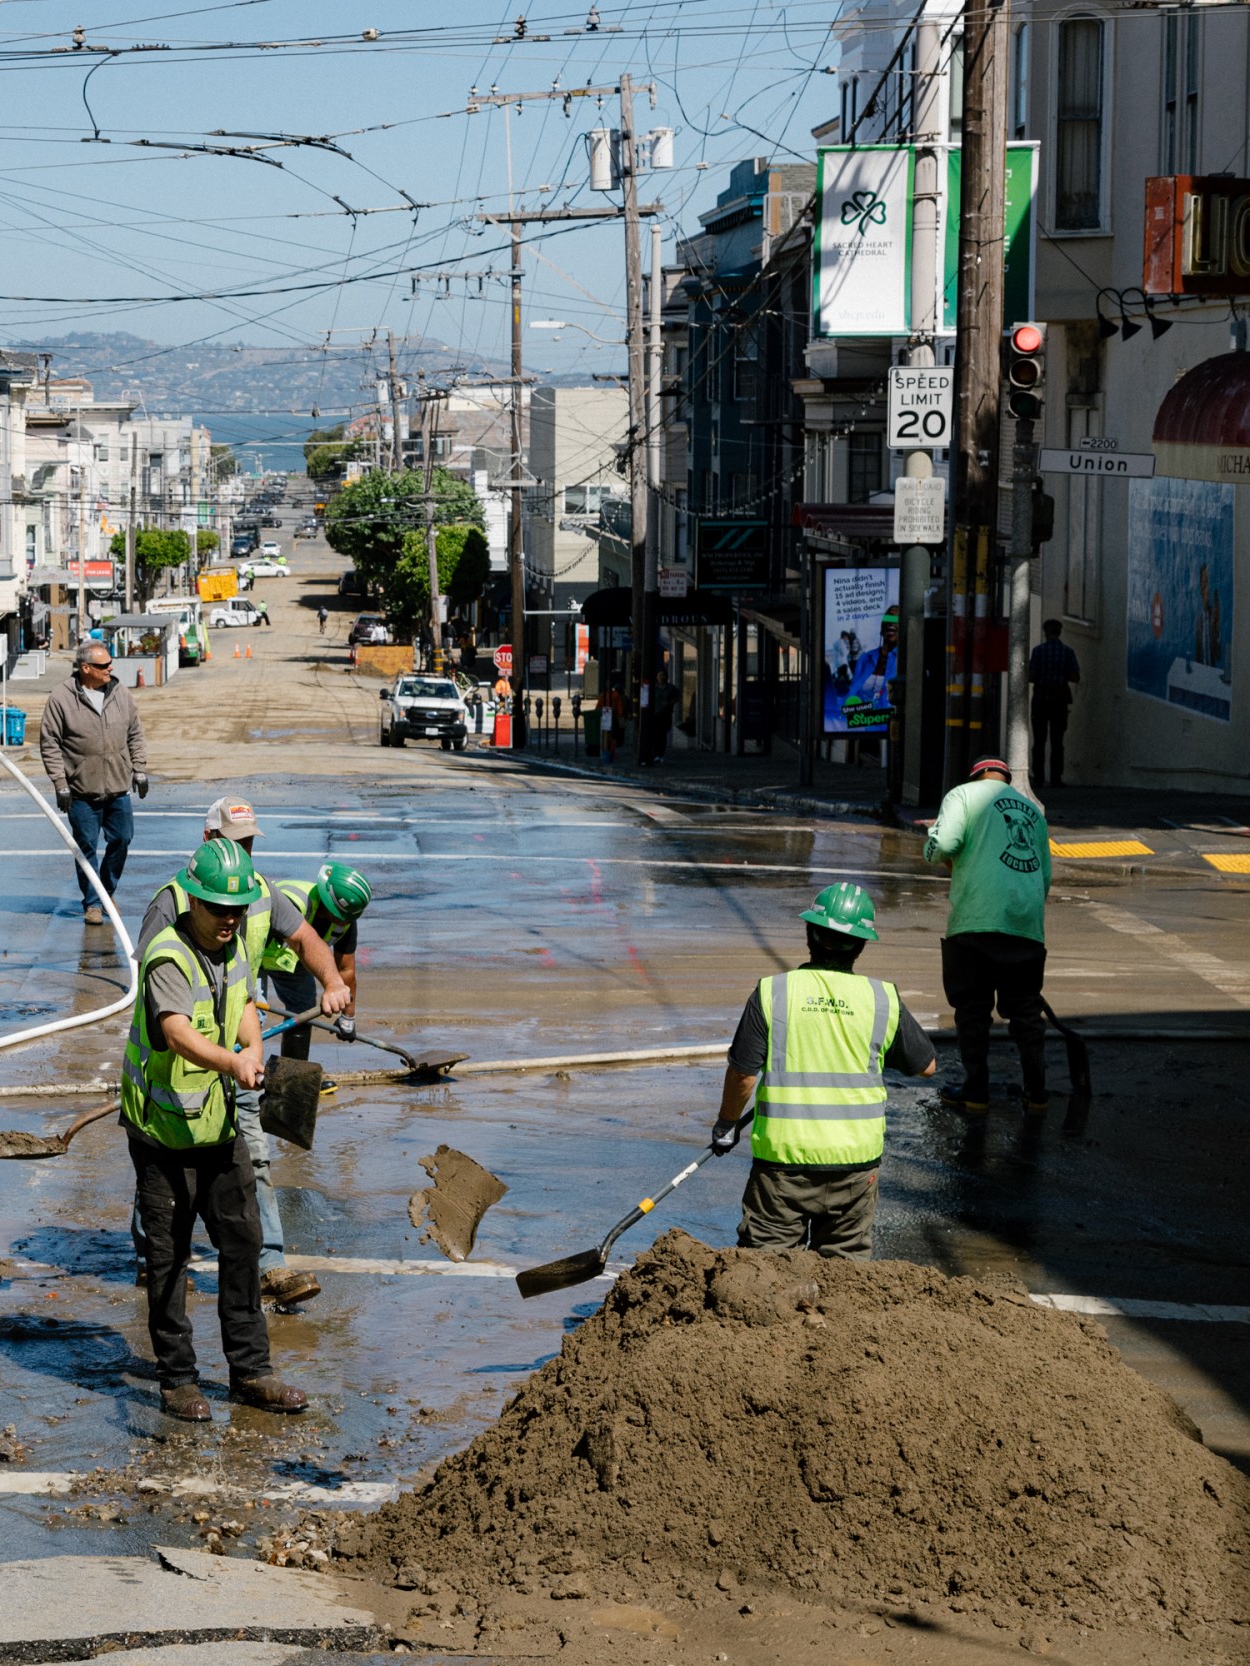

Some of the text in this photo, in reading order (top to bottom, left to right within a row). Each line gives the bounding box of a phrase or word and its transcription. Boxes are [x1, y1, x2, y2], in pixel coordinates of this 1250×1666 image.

[866, 241, 893, 249] HEART
[895, 377, 949, 389] SPEED
[901, 393, 942, 405] LIMIT
[896, 410, 946, 439] 20
[1090, 438, 1117, 449] 2200
[1070, 455, 1127, 472] Union
[904, 498, 935, 506] BICYCLE
[907, 507, 931, 515] RIDING
[898, 515, 940, 523] PROHIBITED
[908, 524, 941, 532] SIDEWALK
[833, 574, 873, 585] Nina didn't
[834, 580, 885, 592] actually finish
[844, 591, 855, 599] ad
[855, 588, 887, 598] designs,
[869, 595, 883, 604] and
[843, 605, 862, 613] sales
[863, 603, 881, 612] deck
[845, 613, 851, 621] 2
[495, 652, 513, 663] STO
[855, 702, 873, 712] used
[995, 799, 1038, 822] LABORERS
[1002, 853, 1029, 871] LOCAL
[806, 996, 849, 1009] S.F.W.D.
[820, 1007, 855, 1016] OPRATONS
